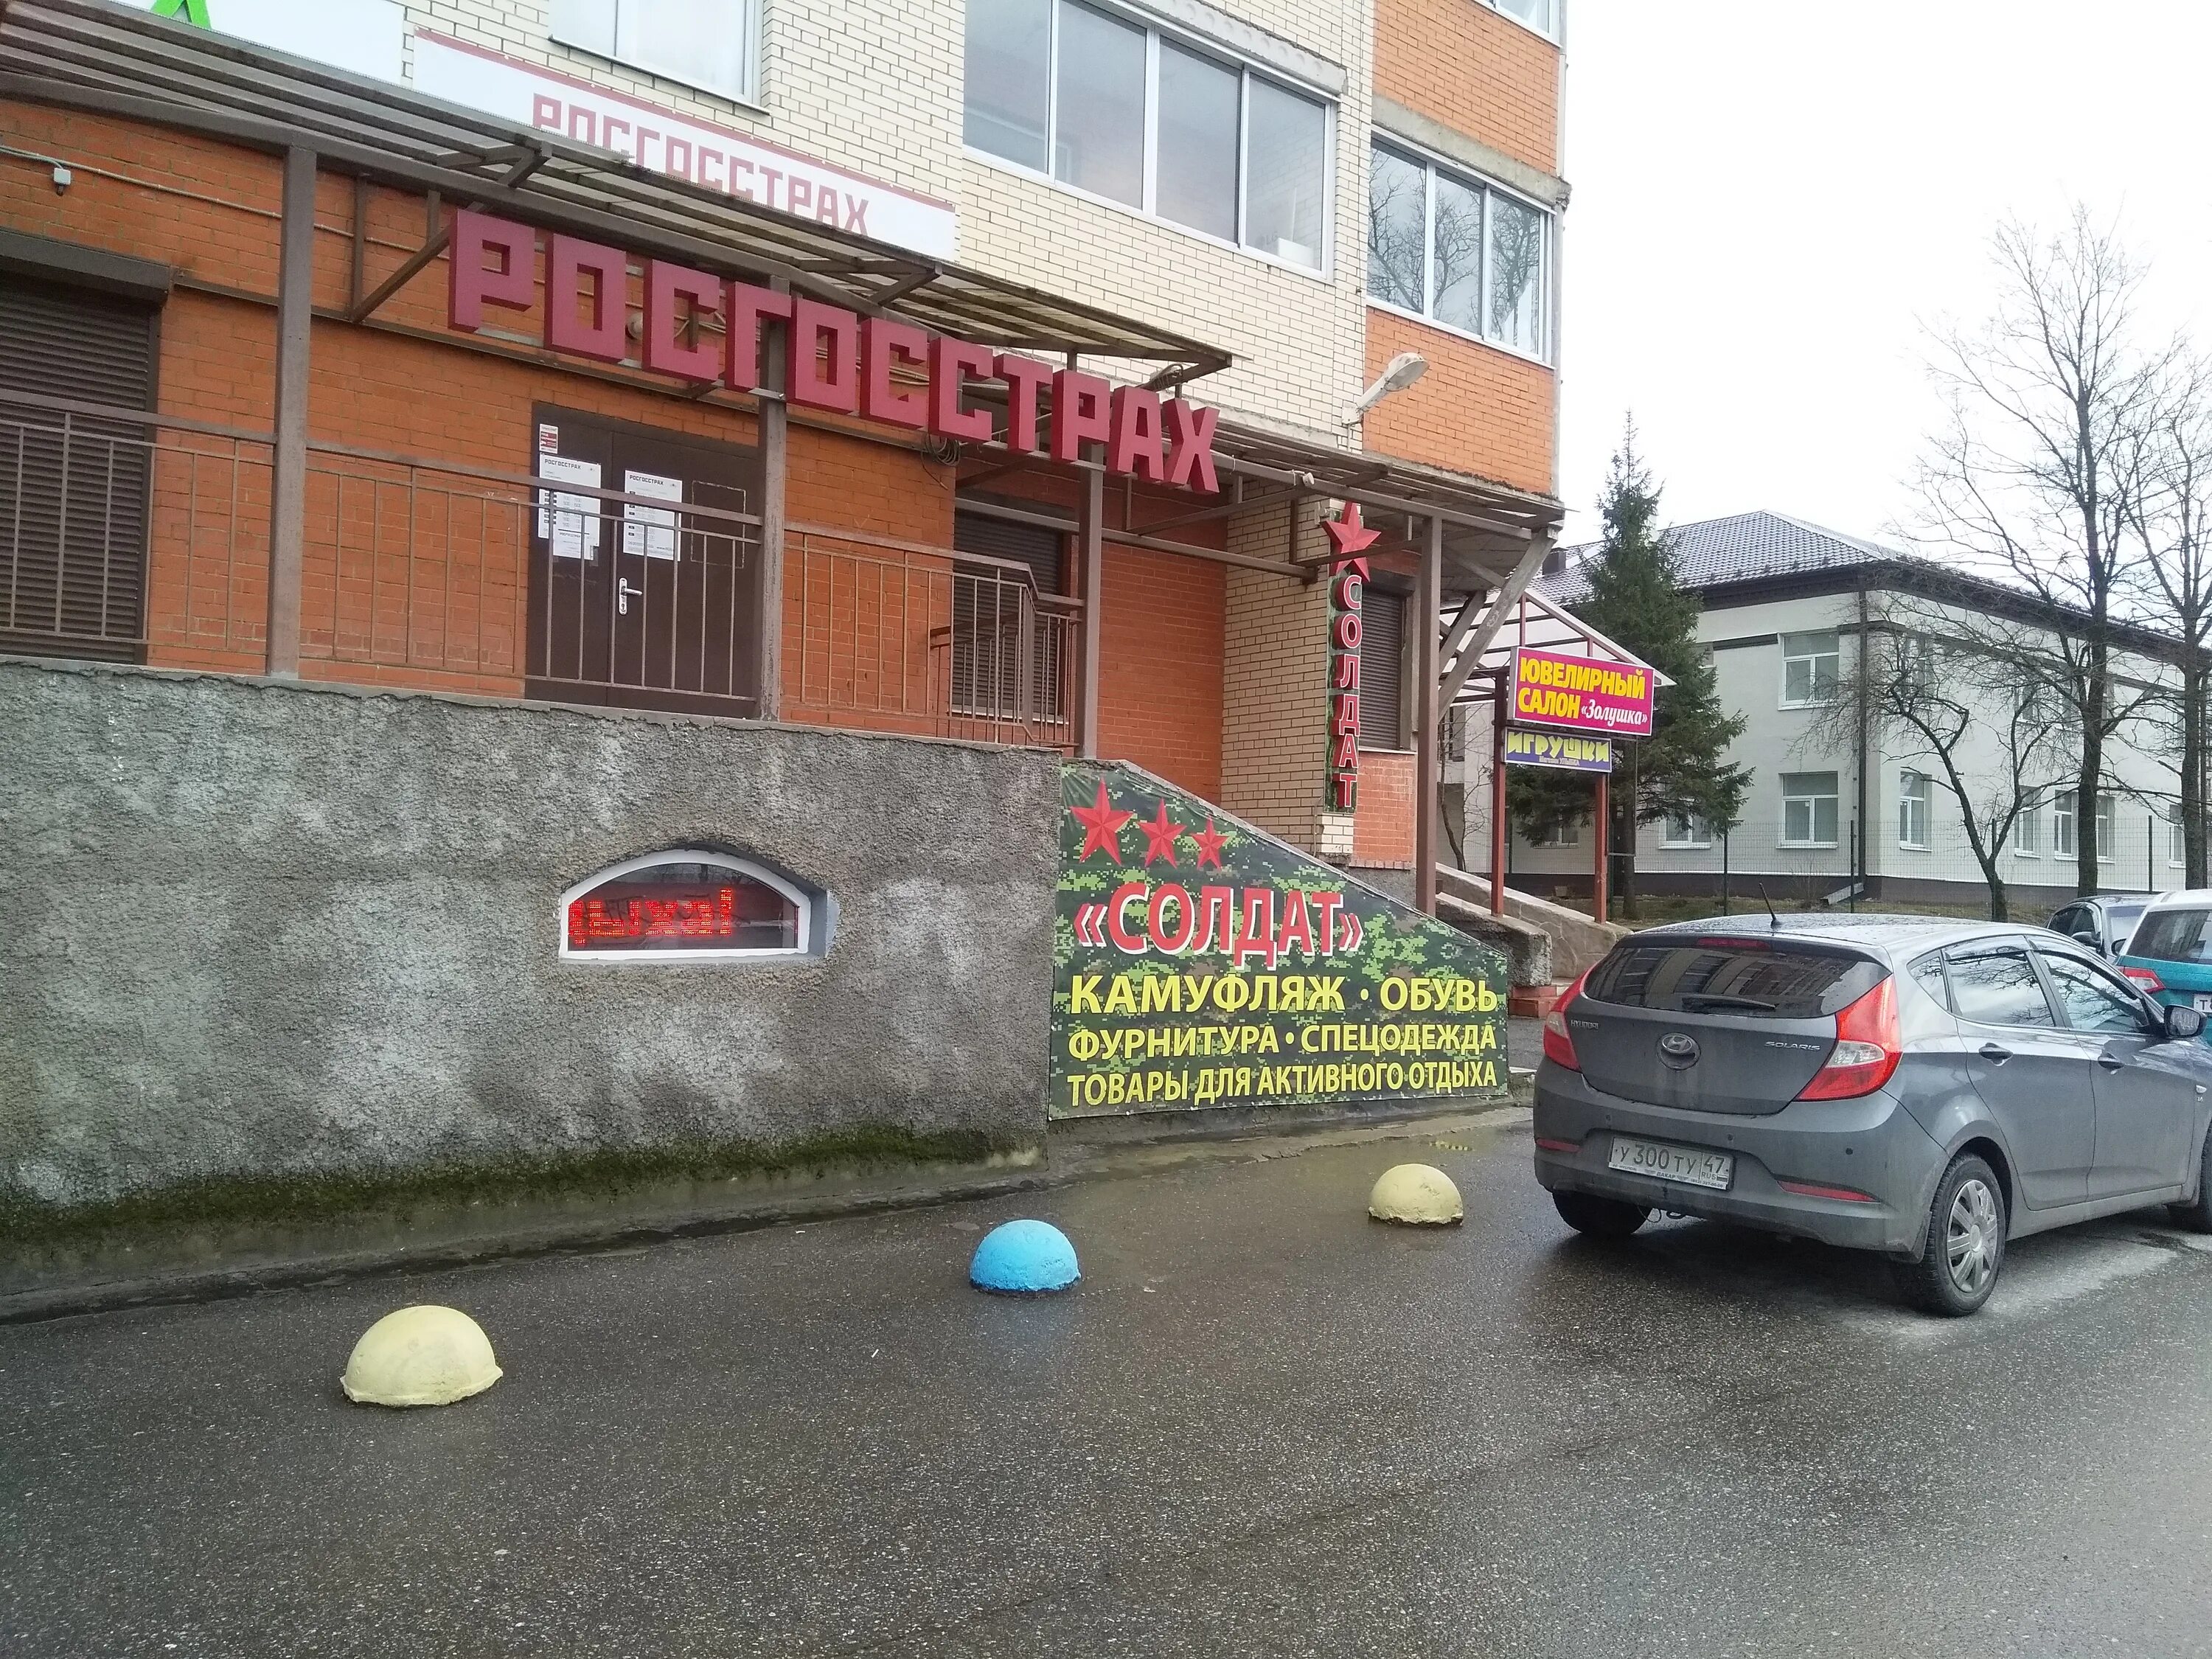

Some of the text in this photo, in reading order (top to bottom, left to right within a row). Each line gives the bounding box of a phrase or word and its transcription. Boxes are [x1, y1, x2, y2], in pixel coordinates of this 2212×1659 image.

[533, 93, 869, 236] РОСГОССТРАХ
[448, 209, 1220, 494] РОСГОССТРАХ
[545, 459, 581, 470] РОСГОССТРАХ
[630, 474, 664, 486] РОСГОССТРАХ
[1333, 574, 1363, 808] СОЛДАТ
[1520, 656, 1645, 699] ЮВЕЛИРНЫЙ
[1518, 687, 1648, 727] САЛОН «Золушка»
[1508, 731, 1609, 762] ИГРУШКИ
[1074, 883, 1363, 971] «СОЛДАТ»
[1071, 974, 1498, 1015] КАМУФЛЯЖ ОБУВЬ
[1068, 1023, 1497, 1061] ФУРНИТУРА СПЕЦОДЕЖДА
[1764, 1041, 1820, 1051] SOLARIS
[1067, 1061, 1498, 1106] ТОВАРЫ ДЛЯ АКТИВНОГО ОТДЫХА
[1701, 1172, 1717, 1180] RUS
[1704, 1155, 1725, 1173] 47
